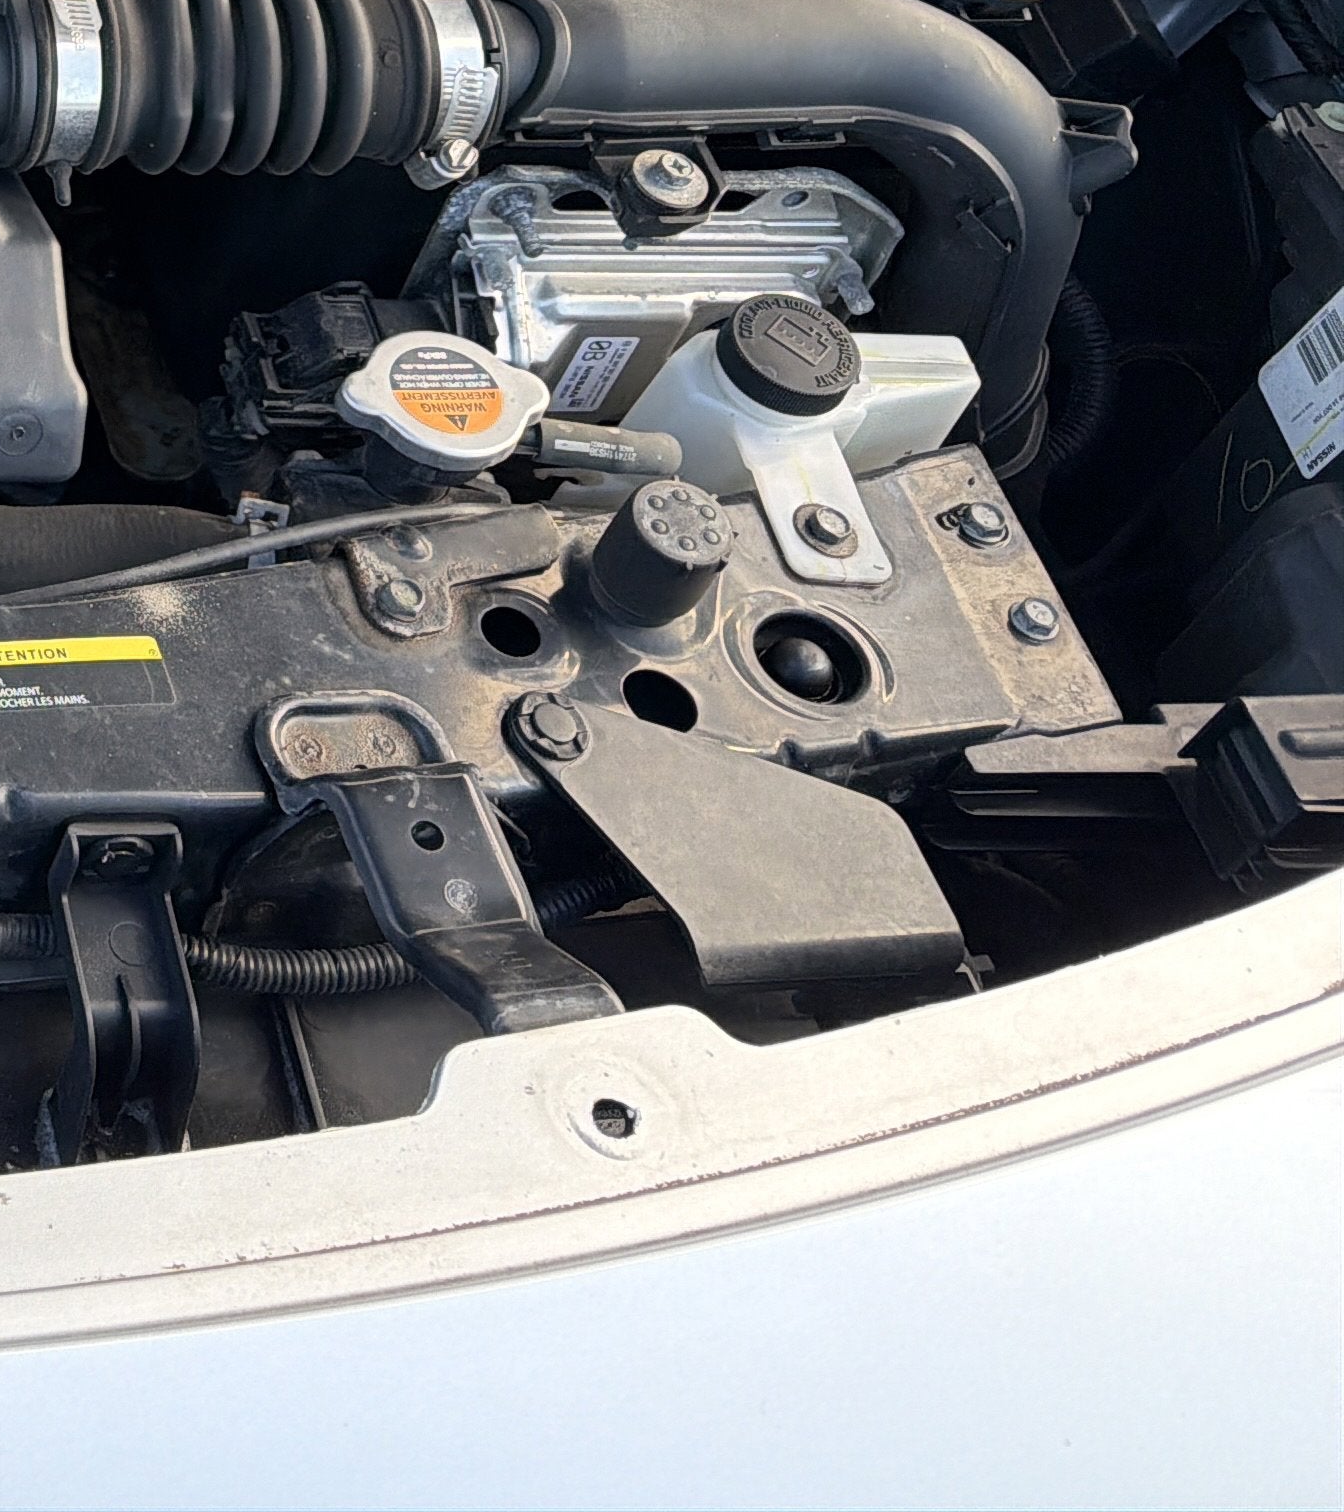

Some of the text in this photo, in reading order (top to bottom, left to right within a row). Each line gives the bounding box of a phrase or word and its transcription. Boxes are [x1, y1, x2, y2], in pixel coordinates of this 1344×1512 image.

[401, 392, 496, 400] AVERTISSEMENT
[420, 402, 487, 412] WARNING
[1306, 441, 1337, 472] NISSAN
[36, 697, 53, 706] LES
